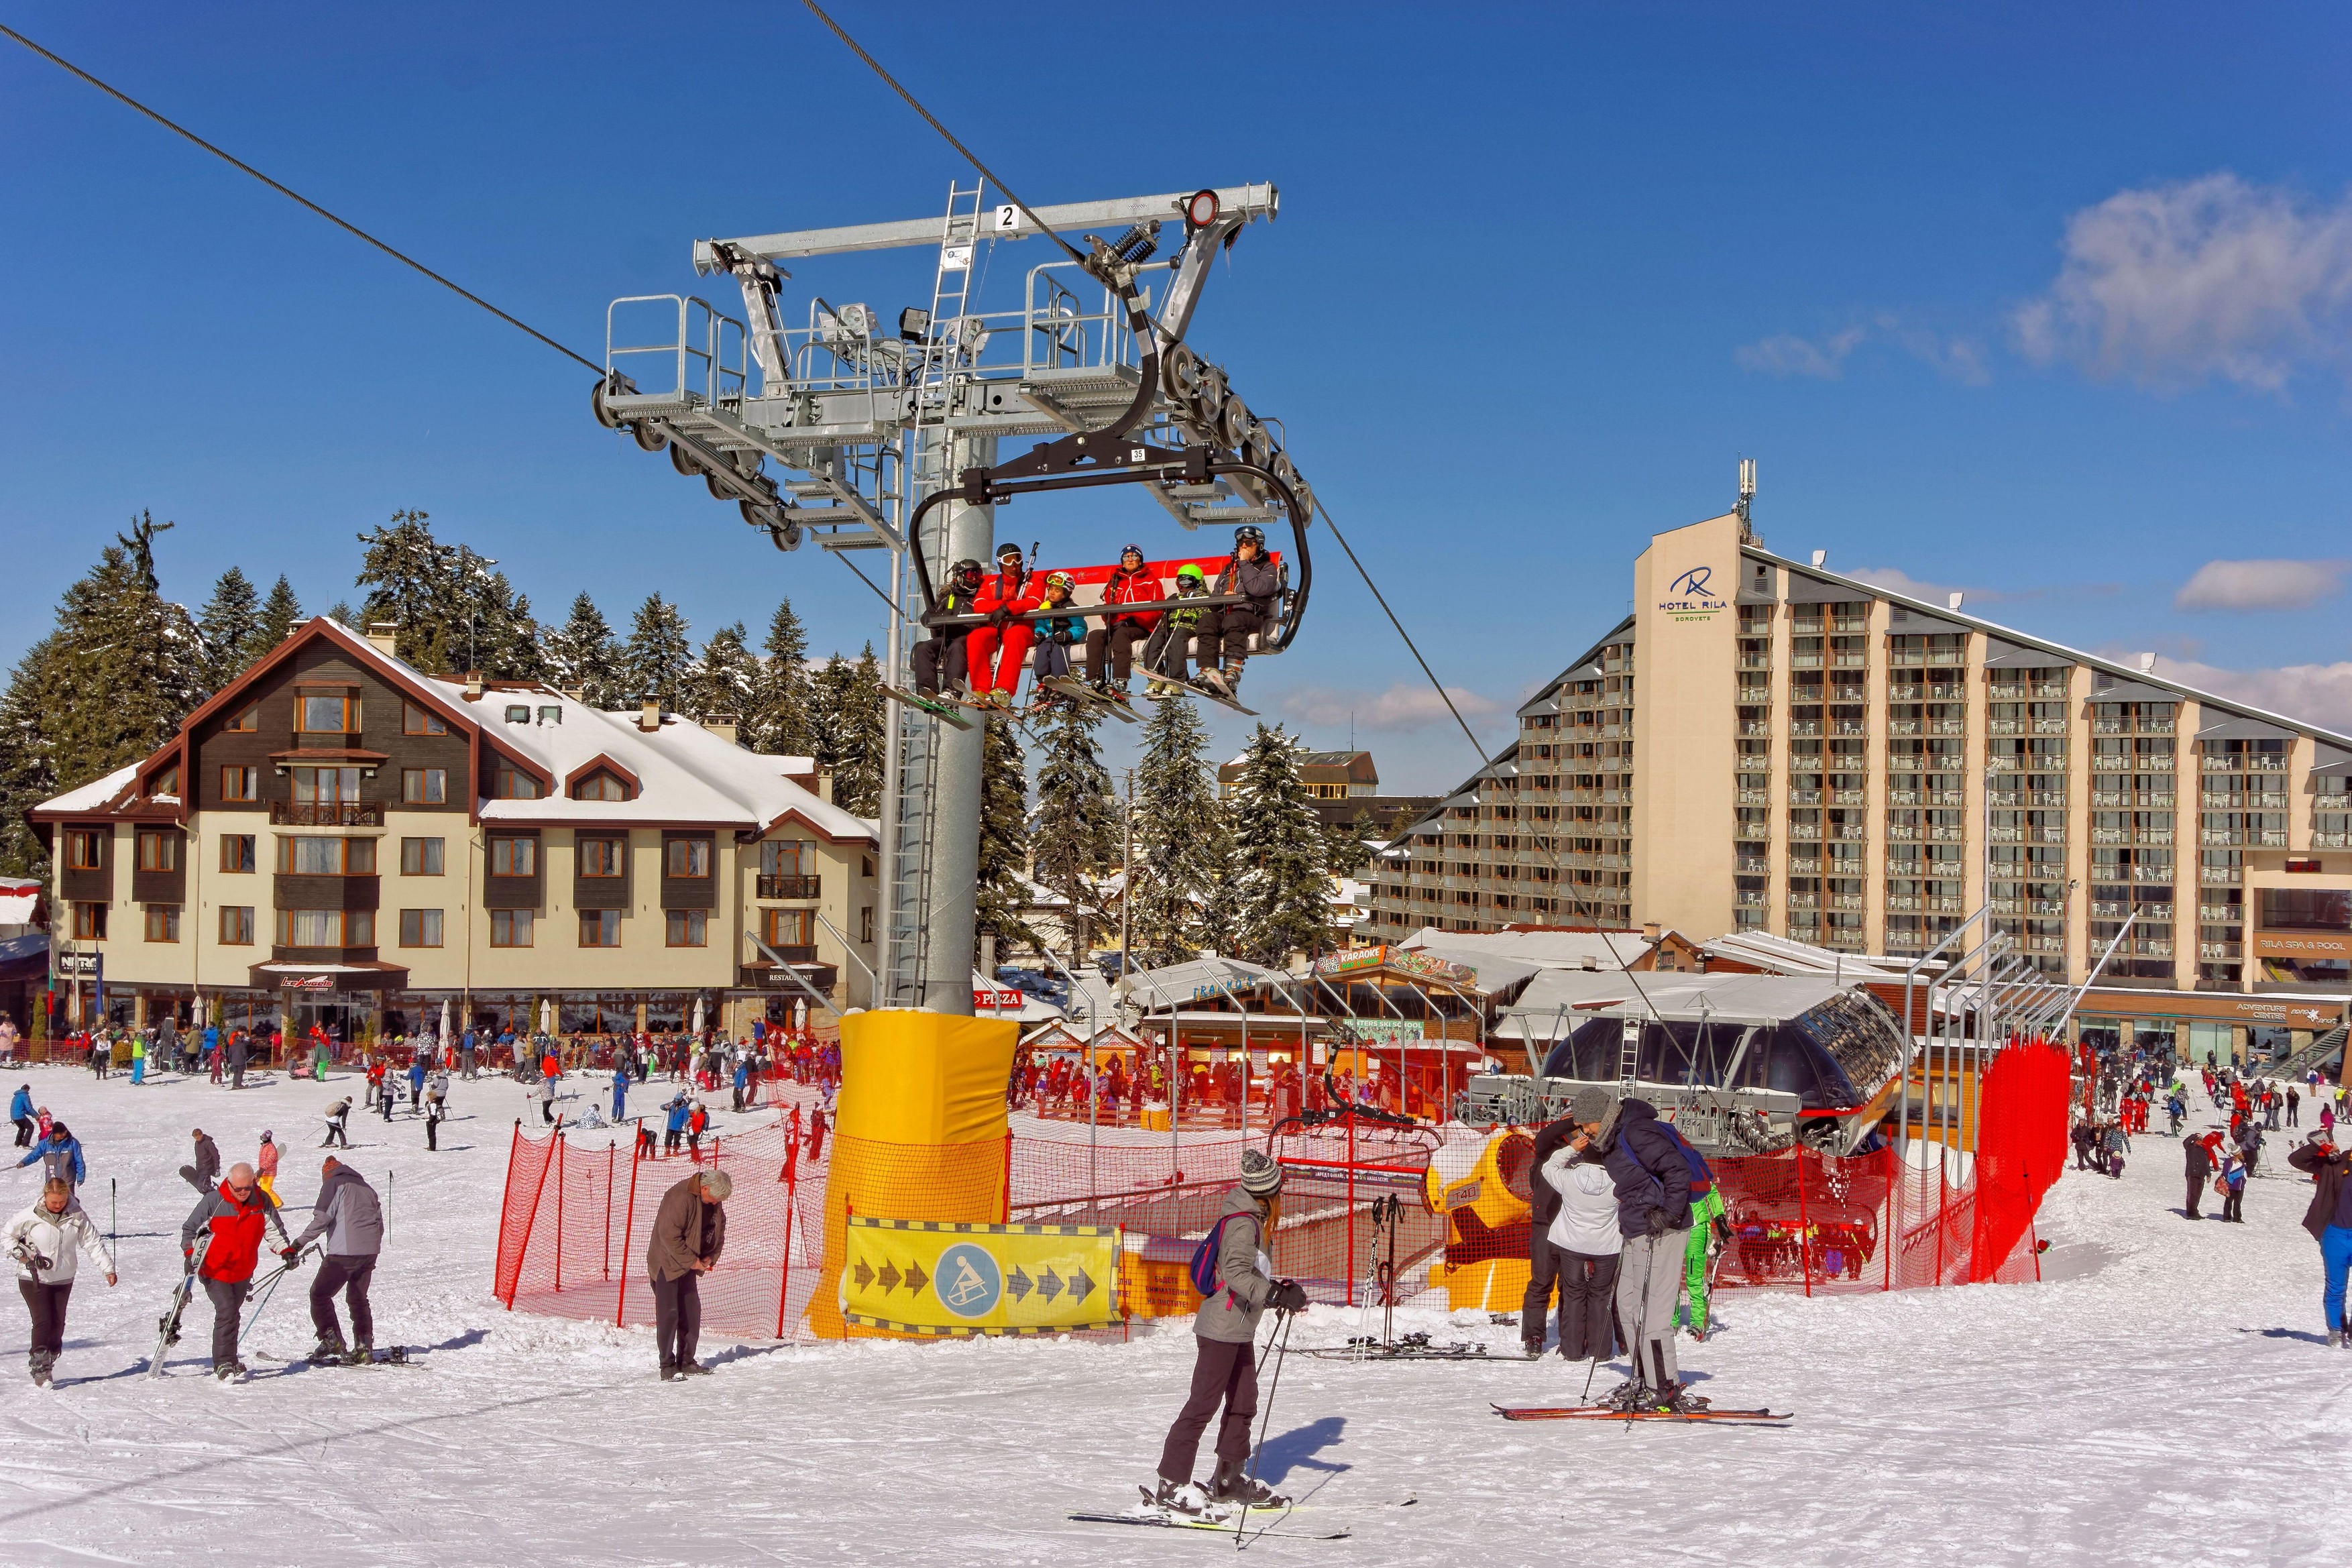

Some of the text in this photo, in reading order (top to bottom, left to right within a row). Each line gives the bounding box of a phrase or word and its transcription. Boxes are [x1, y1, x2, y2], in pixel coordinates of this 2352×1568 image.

[1002, 207, 1013, 226] 2
[1134, 450, 1142, 458] 35
[1659, 601, 1727, 610] HOTEL RILA
[2260, 940, 2284, 948] RILA
[2286, 941, 2305, 949] SPA
[2316, 942, 2345, 950] POOL
[61, 956, 97, 967] NIRO
[1319, 948, 1380, 966] Black KARAOKE
[1324, 964, 1339, 972] tiger
[1342, 961, 1354, 969] BAR
[1363, 957, 1379, 966] FOOD
[2237, 1003, 2286, 1012] ADVENTURE
[2253, 1011, 2286, 1020] CENTER
[1454, 1186, 1476, 1201] T40
[1154, 1276, 1178, 1284] БЪДЕТЕ
[1145, 1286, 1189, 1296] ВНИМАТЕЛНИ
